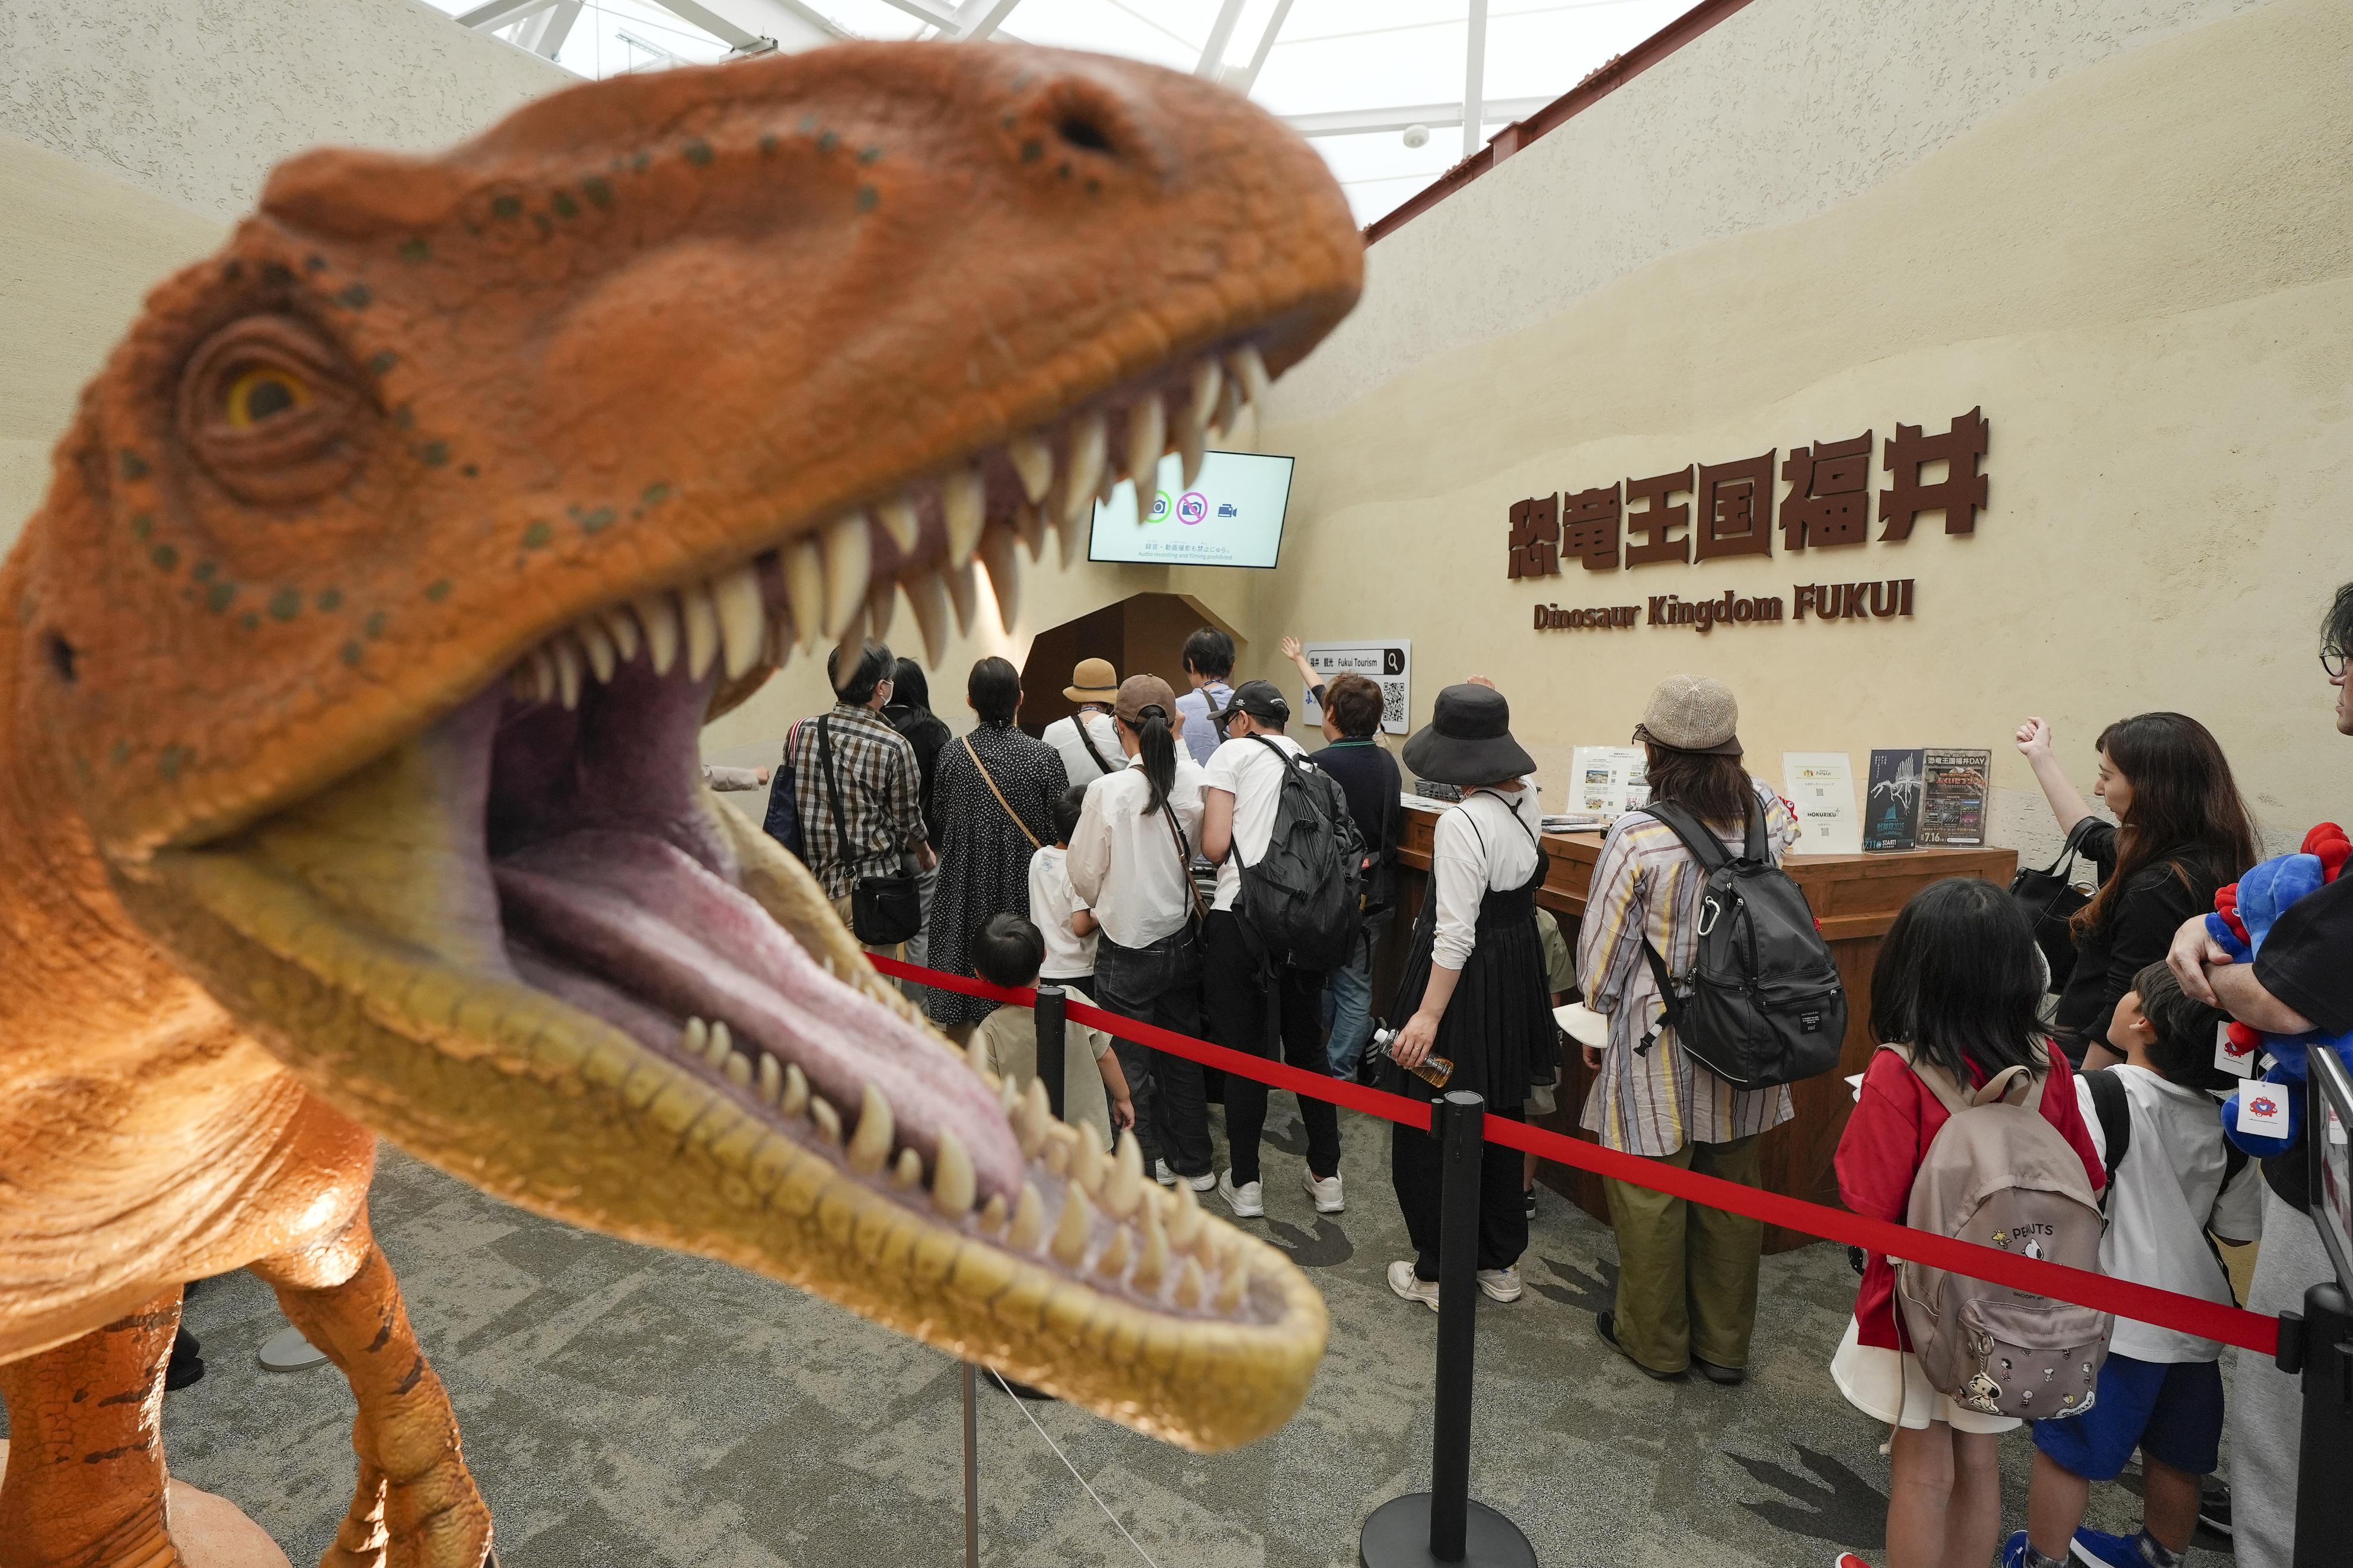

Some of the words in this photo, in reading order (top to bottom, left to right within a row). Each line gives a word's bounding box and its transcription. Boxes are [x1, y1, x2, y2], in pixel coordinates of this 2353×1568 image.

[1507, 405, 1989, 579] 恐竜王国福井
[1533, 602, 1642, 630] Dinosaur
[1647, 590, 1783, 633] Kingdom
[1792, 579, 1915, 620] FUKUI
[1310, 657, 1319, 667] 福井
[1324, 657, 1334, 667] 観光
[1338, 657, 1353, 667] Fukui
[1354, 657, 1378, 667] Tourism
[1924, 832, 1940, 842] 7.16
